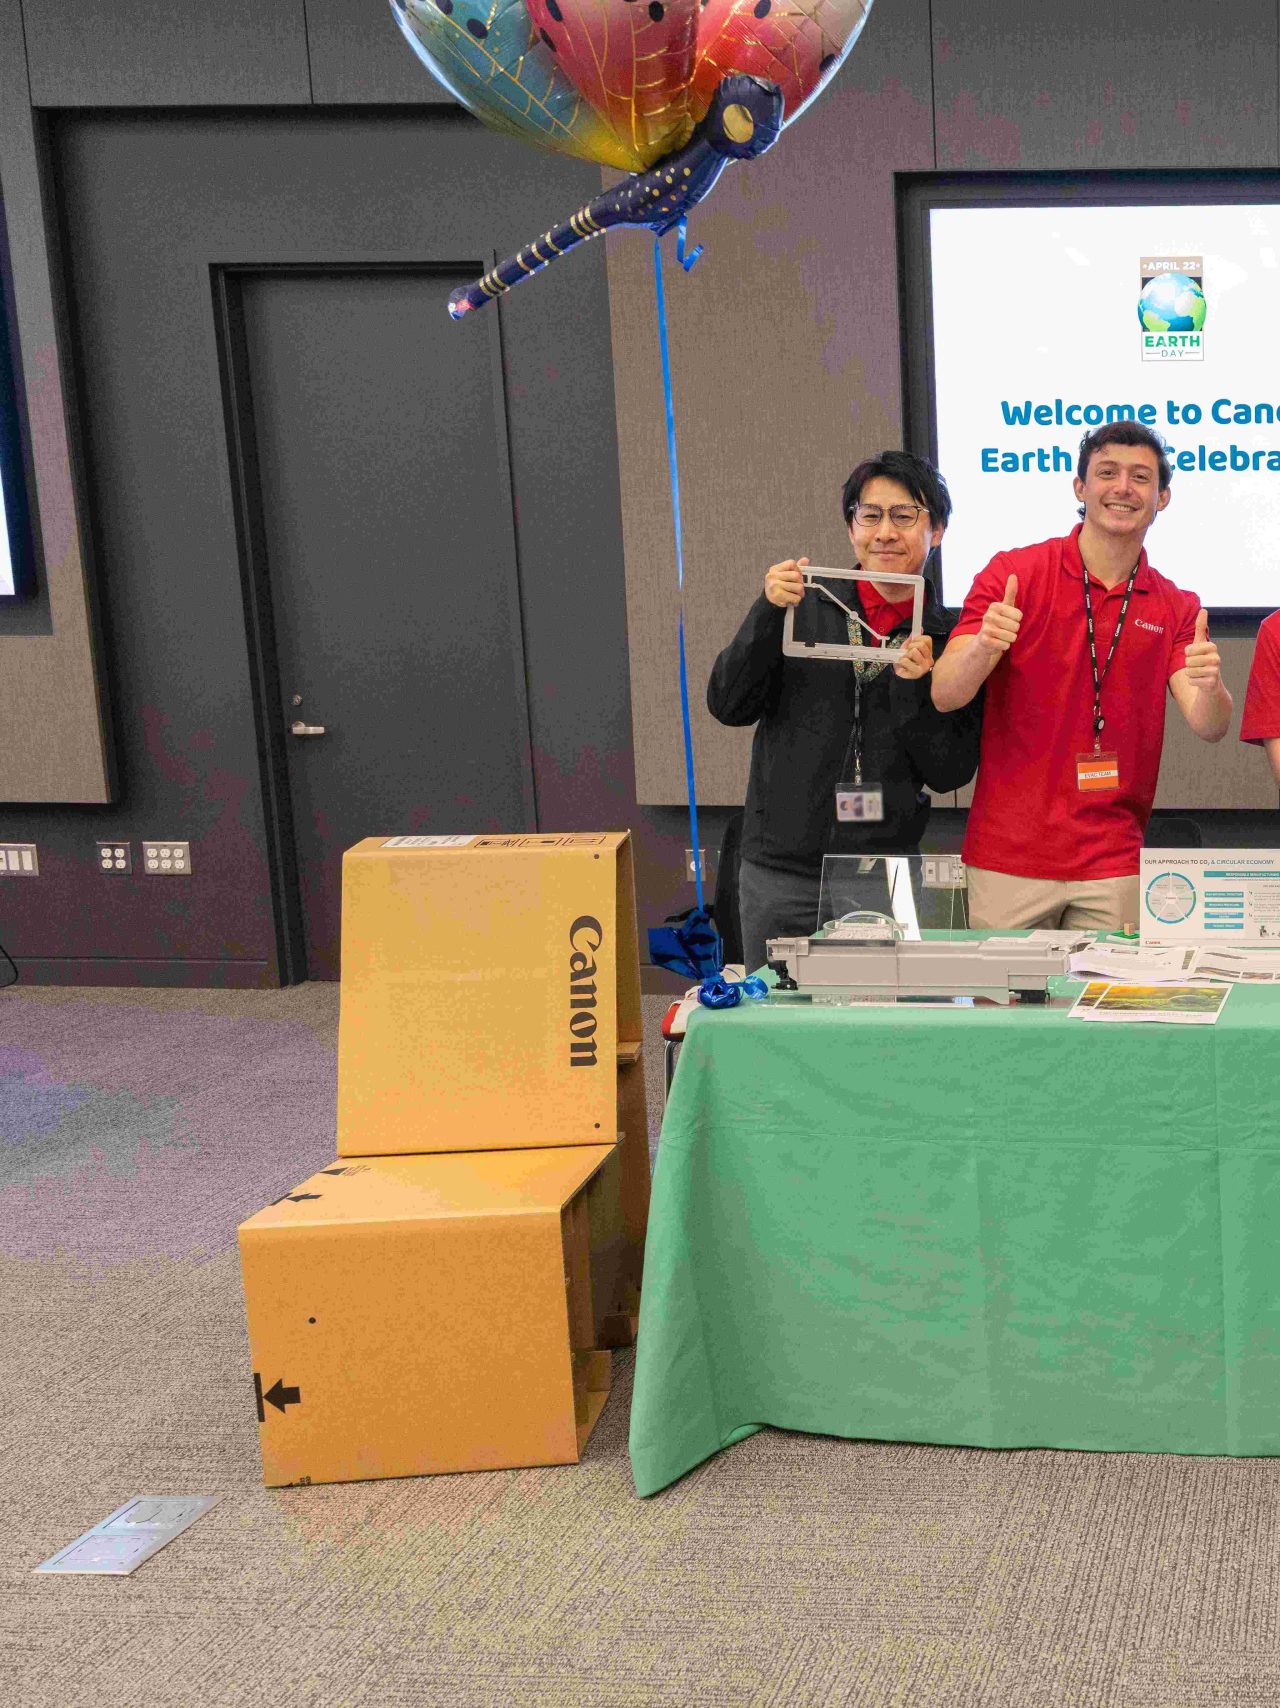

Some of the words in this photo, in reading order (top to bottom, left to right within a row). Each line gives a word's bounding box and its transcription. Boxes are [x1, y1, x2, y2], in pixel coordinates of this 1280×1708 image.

[1147, 261, 1180, 271] APRIL
[1182, 261, 1196, 271] 22
[1144, 335, 1201, 348] EARTH
[1161, 349, 1185, 358] DAY
[1000, 398, 1157, 426] Welcome
[1166, 399, 1202, 425] to
[981, 446, 1072, 473] Earth
[1134, 618, 1164, 635] Canon
[569, 915, 603, 1067] Canon
